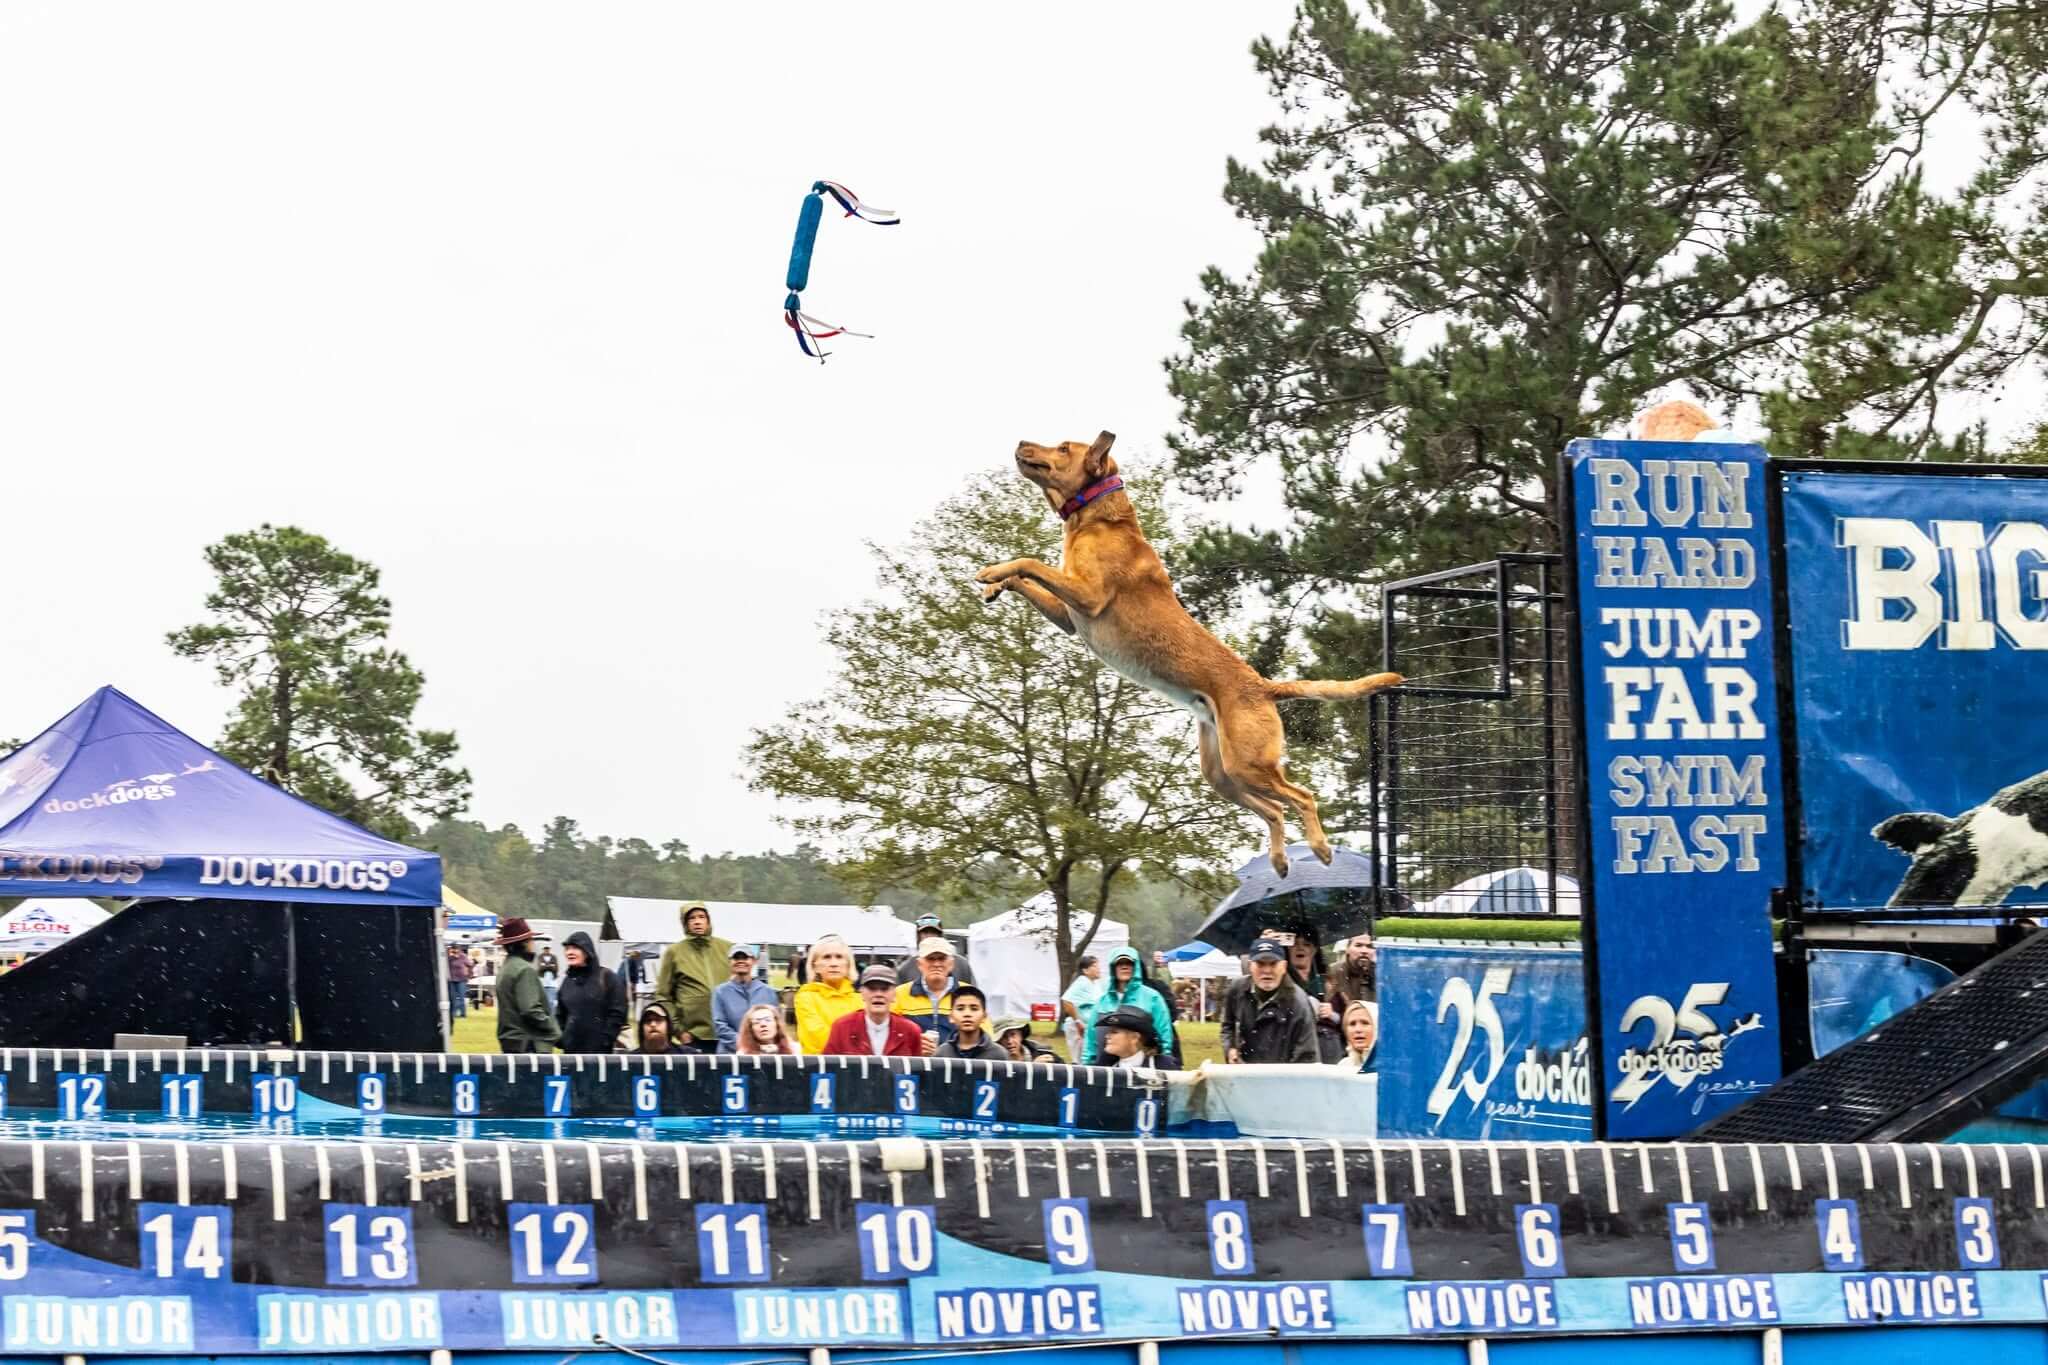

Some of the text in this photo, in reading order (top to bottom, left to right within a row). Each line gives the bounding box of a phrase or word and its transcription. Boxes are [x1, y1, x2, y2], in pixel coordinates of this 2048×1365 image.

[1589, 458, 1753, 528] RUN
[1594, 536, 1756, 588] HARD
[1836, 516, 2048, 650] BIG
[1600, 608, 1761, 659] JUMP
[1606, 666, 1766, 740] FAR
[43, 783, 176, 814] dockdogs
[1608, 755, 1767, 807] SWIM
[1611, 814, 1767, 874] FAST
[8, 922, 71, 933] ELGIN
[1617, 1048, 1724, 1075] dockdogs
[164, 1079, 200, 1118] 11
[254, 1078, 296, 1112] 10
[362, 1077, 384, 1113] 9
[455, 1080, 476, 1115] 8
[548, 1080, 567, 1112] 7
[636, 1078, 657, 1111] 6
[725, 1078, 745, 1110] 5
[813, 1078, 833, 1109] 4
[898, 1079, 917, 1111] 3
[976, 1085, 996, 1117] 2
[1062, 1093, 1076, 1123] 1
[1137, 1100, 1157, 1132] 0
[144, 1215, 223, 1278] 14
[330, 1214, 409, 1279] 13
[514, 1212, 591, 1276] 12
[701, 1214, 766, 1275] 11
[861, 1209, 932, 1275] 10
[1050, 1206, 1089, 1266] 9
[1212, 1211, 1246, 1270] 8
[1369, 1213, 1400, 1269] 7
[1522, 1209, 1558, 1267] 6
[1673, 1208, 1709, 1265] 5
[1826, 1208, 1856, 1263] 4
[1962, 1206, 1994, 1263] 3
[265, 1298, 437, 1345] JUNIOR
[510, 1297, 675, 1341] JUNIOR
[743, 1293, 899, 1337] JUNIOR
[938, 1289, 1100, 1338] NOVICE
[1180, 1286, 1333, 1330] NOVICE
[1408, 1284, 1555, 1328] NOVICE
[1631, 1279, 1777, 1325] NOVICE
[1845, 1277, 1980, 1320] NOVICE
[10, 1300, 192, 1345] JUNIOR
